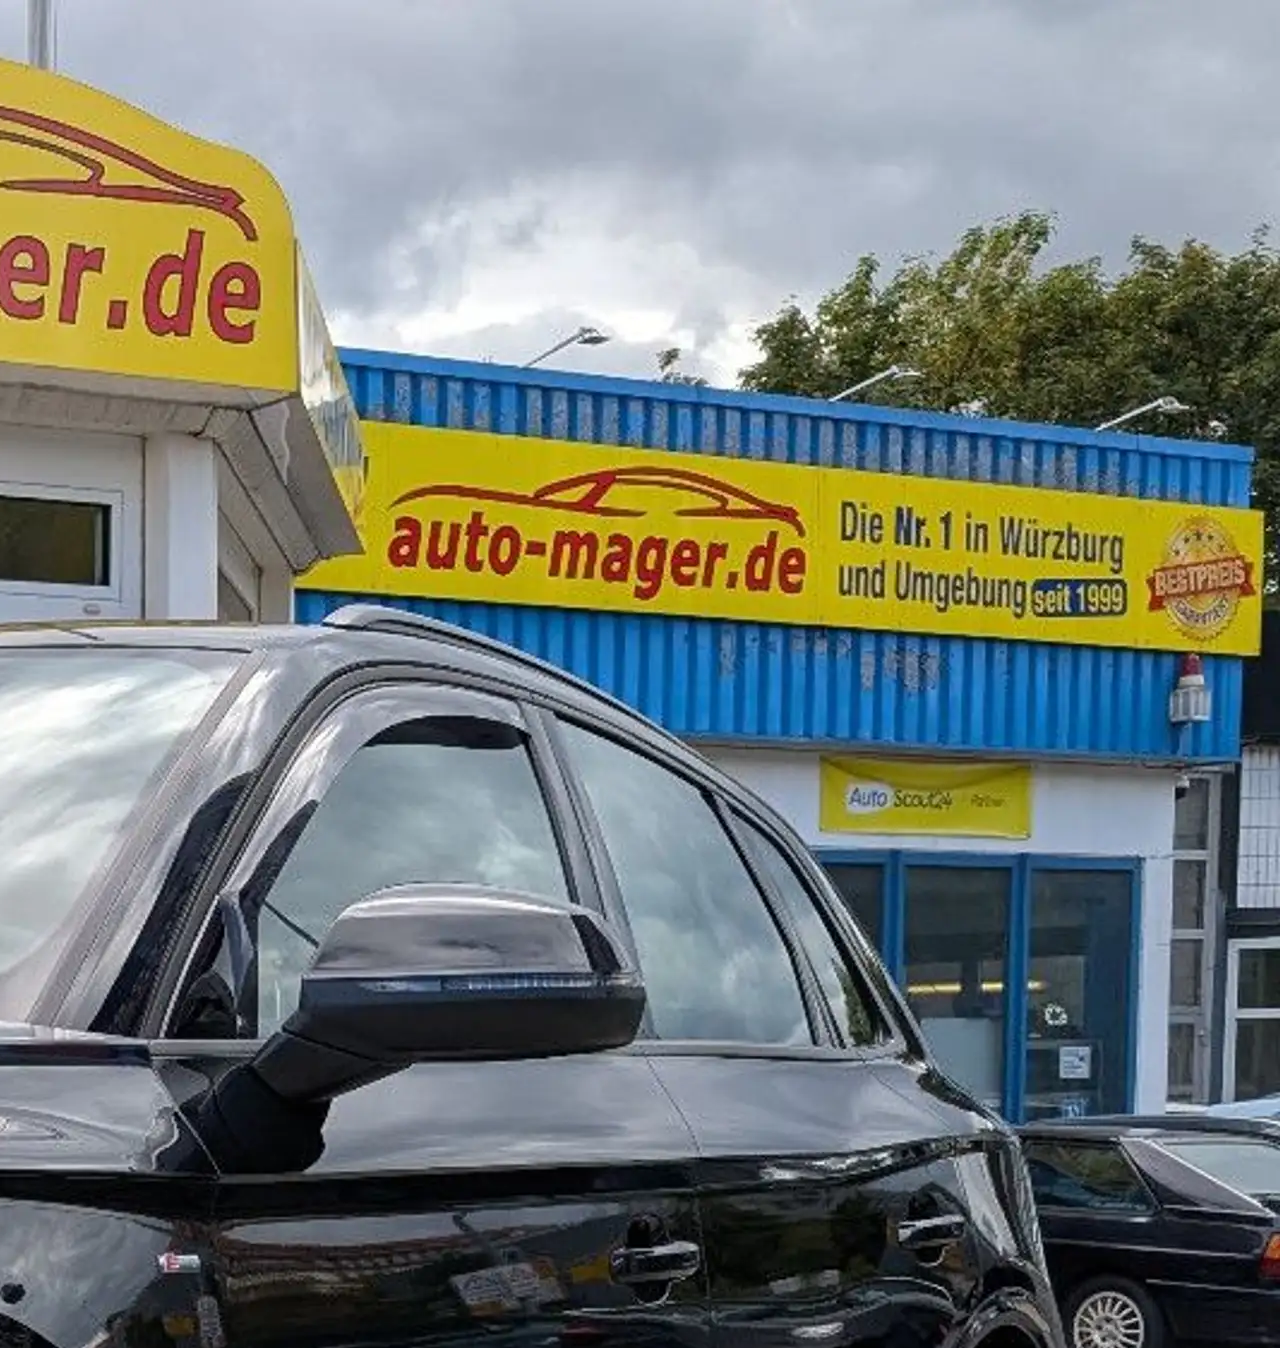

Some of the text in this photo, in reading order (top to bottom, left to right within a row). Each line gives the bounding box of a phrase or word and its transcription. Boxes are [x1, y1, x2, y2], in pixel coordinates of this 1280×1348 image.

[387, 510, 806, 600] auto-mager.de
[840, 501, 1125, 574] Die Nr. 1 in Würzburg
[838, 559, 1125, 618] und Umgebung seit 1999
[1154, 558, 1246, 597] BESTPREIS
[848, 786, 888, 808] Auto
